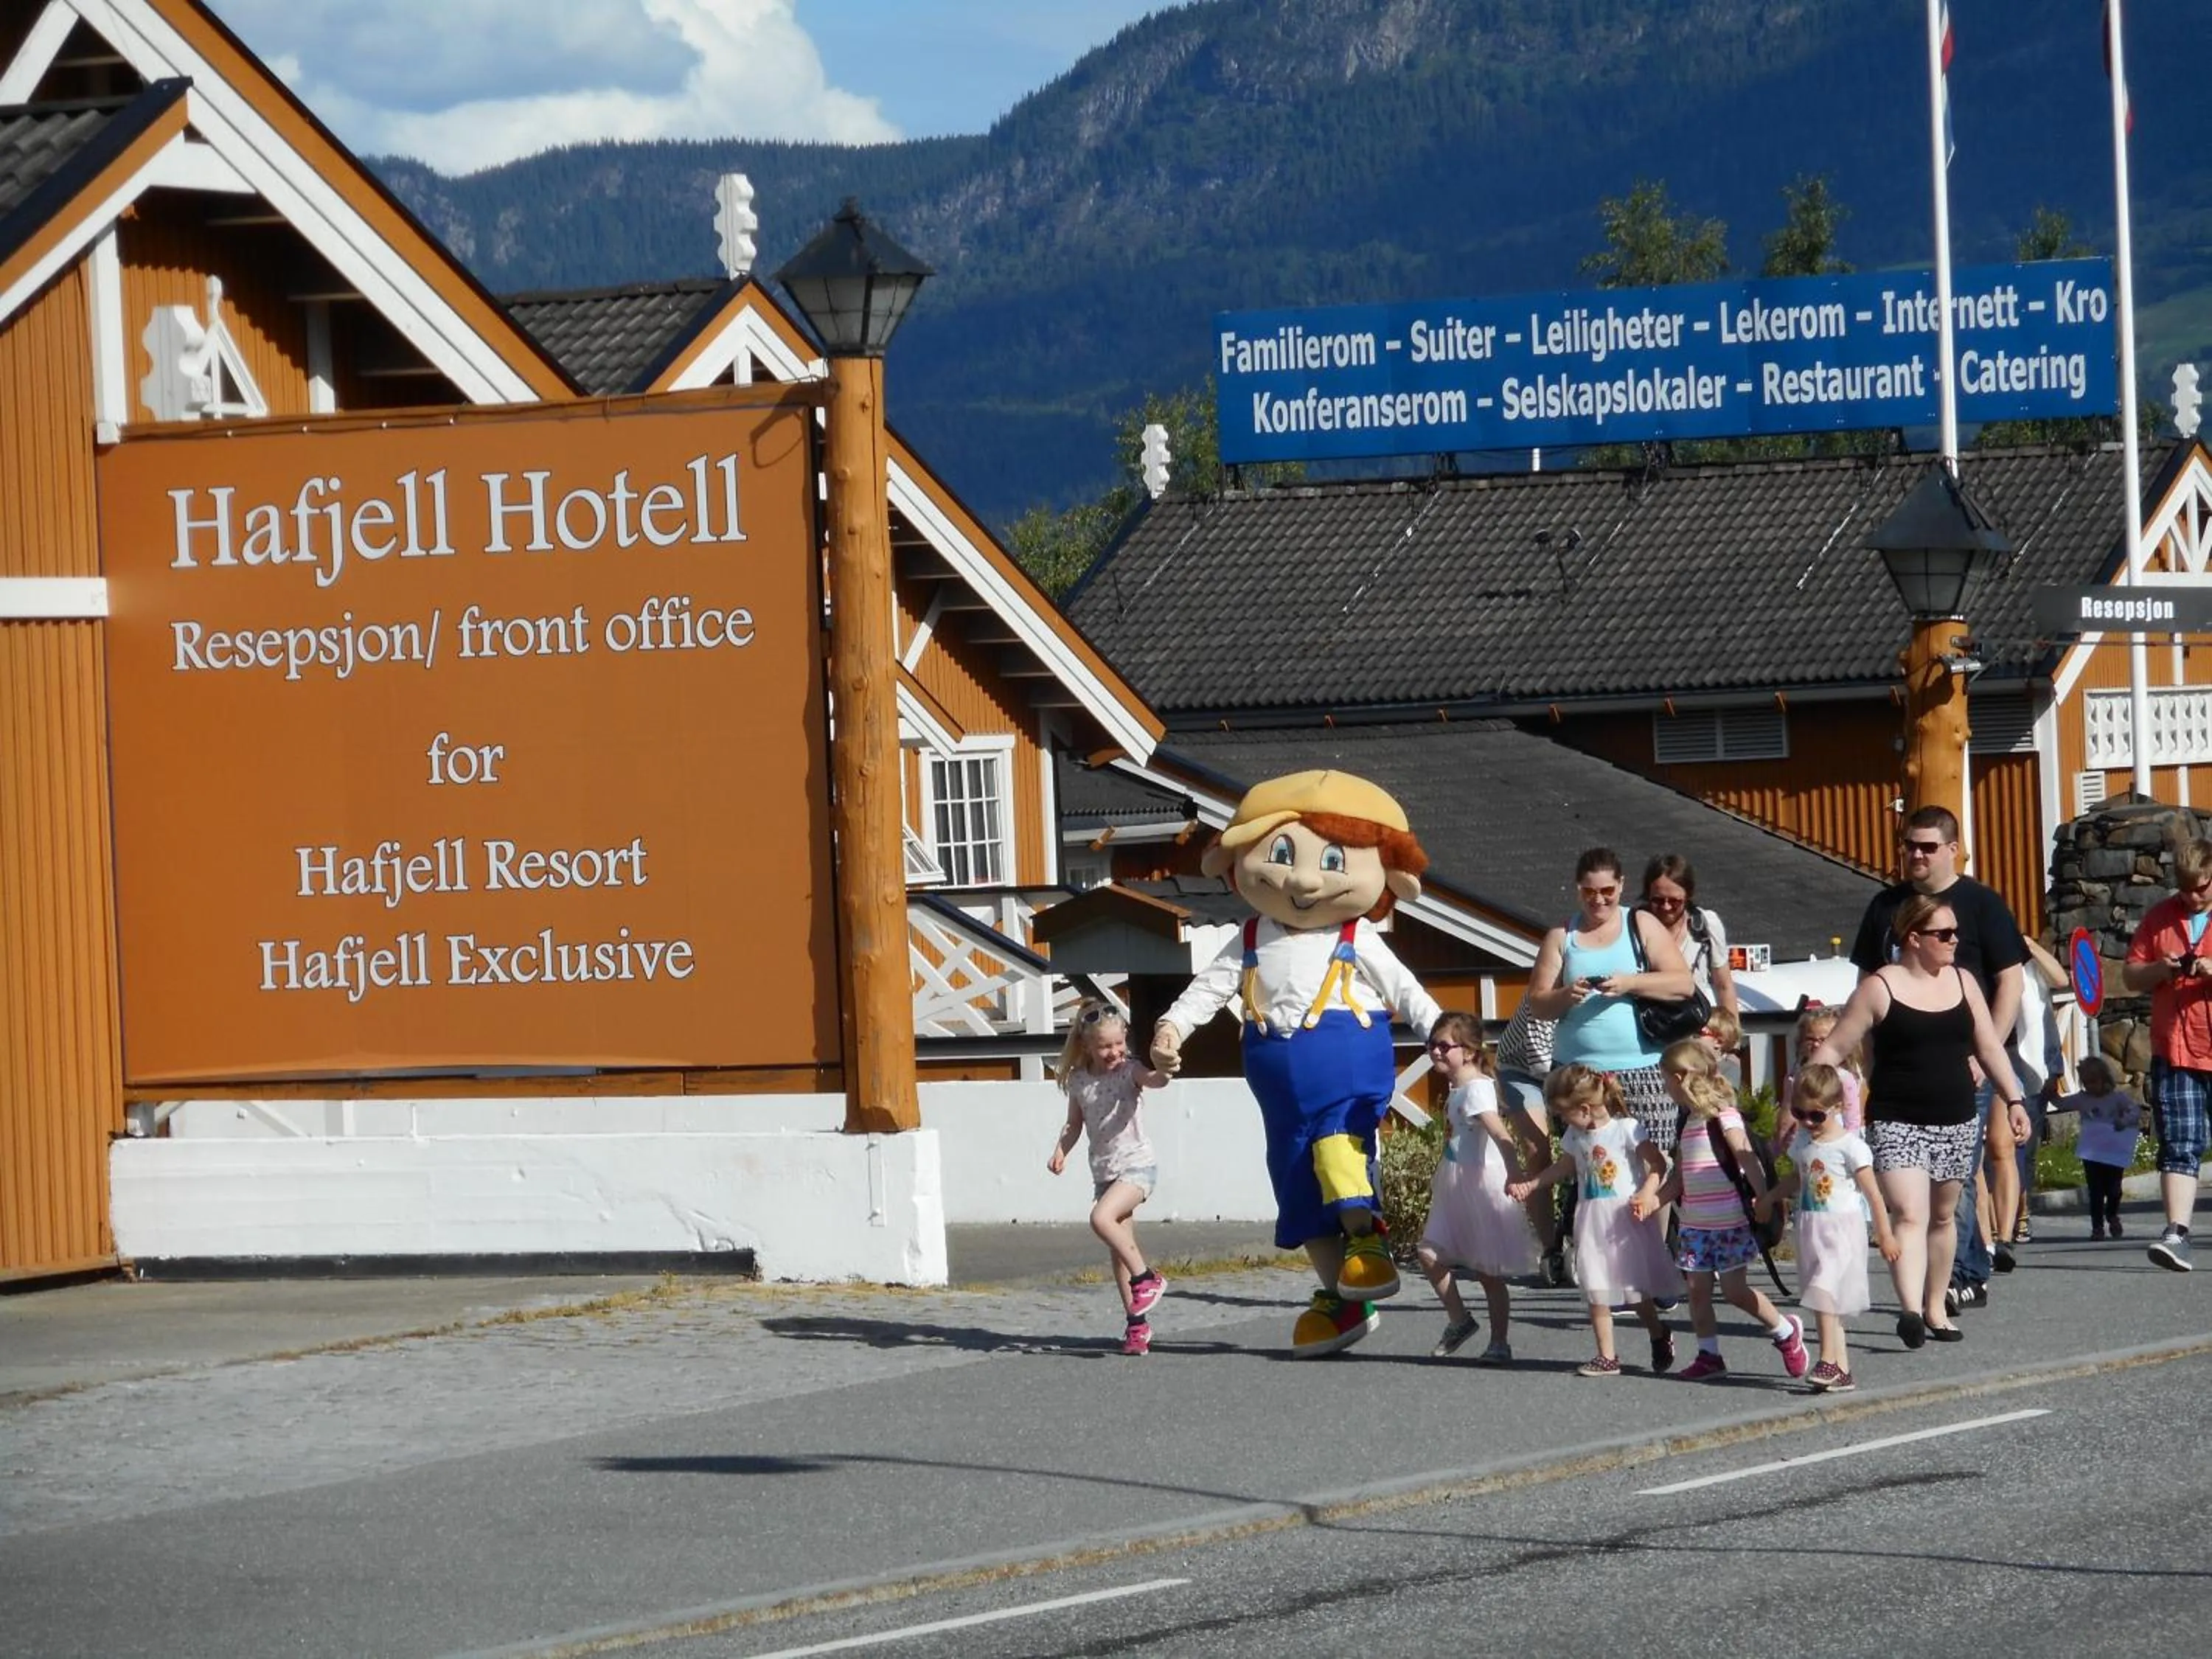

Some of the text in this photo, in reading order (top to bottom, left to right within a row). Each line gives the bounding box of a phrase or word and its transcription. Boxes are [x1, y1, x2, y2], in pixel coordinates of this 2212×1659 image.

[1219, 325, 1377, 375] Familierom
[1410, 316, 1498, 363] Suiter
[1530, 305, 1686, 364] Leiligheter
[1719, 297, 1847, 345] Lekerom
[2054, 279, 2109, 325] Kro
[1251, 386, 1468, 435] Konferanserom
[1500, 364, 1728, 427] Selskapslokaler
[1761, 354, 1927, 406] Restaurant
[1959, 344, 2087, 400] Catering
[167, 453, 748, 588] Hafjell Hotell
[170, 595, 755, 681] Resepsjon/ front office
[2079, 595, 2176, 623] Resepsjon
[426, 731, 505, 785] for
[295, 837, 648, 909] Hafjell Resort
[257, 927, 695, 1004] Hafjell Exclusive
